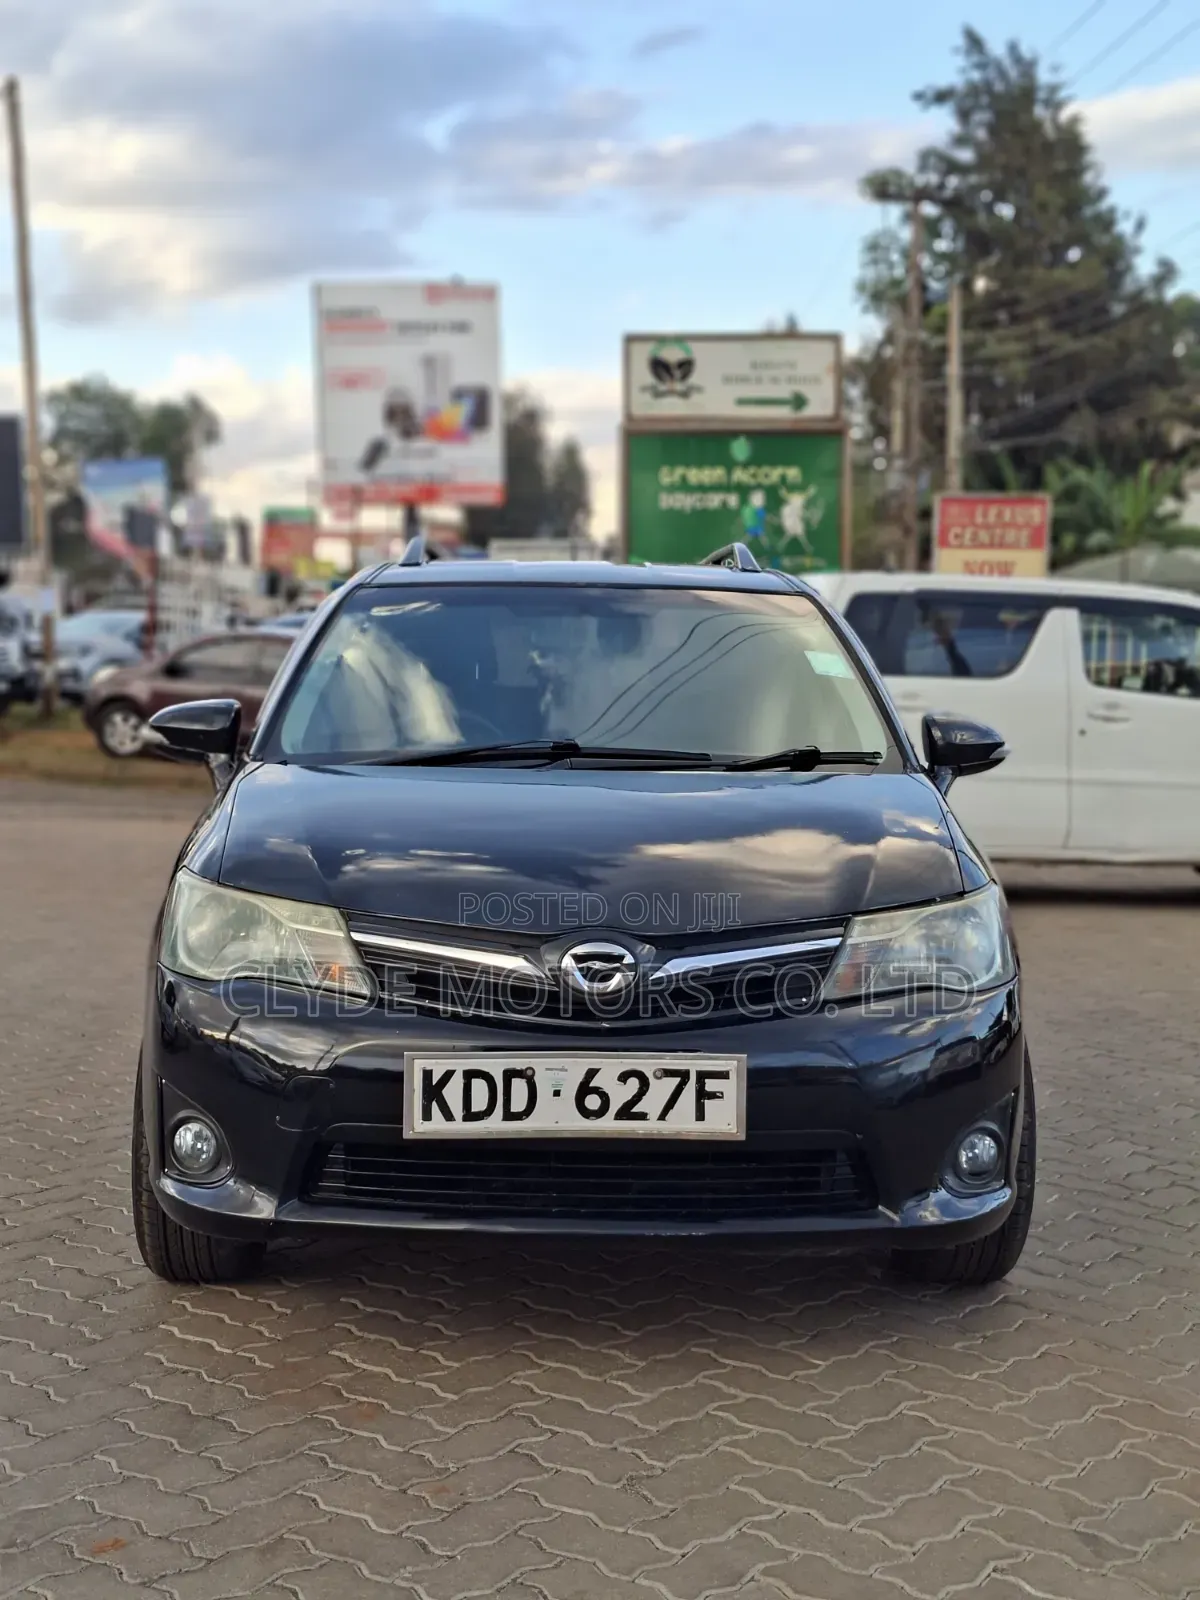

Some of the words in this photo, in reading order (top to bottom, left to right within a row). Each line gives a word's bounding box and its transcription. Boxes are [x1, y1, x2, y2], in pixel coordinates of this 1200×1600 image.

[947, 526, 1031, 548] CENTRE
[421, 1067, 538, 1122] KDD
[574, 1067, 731, 1122] 627F
